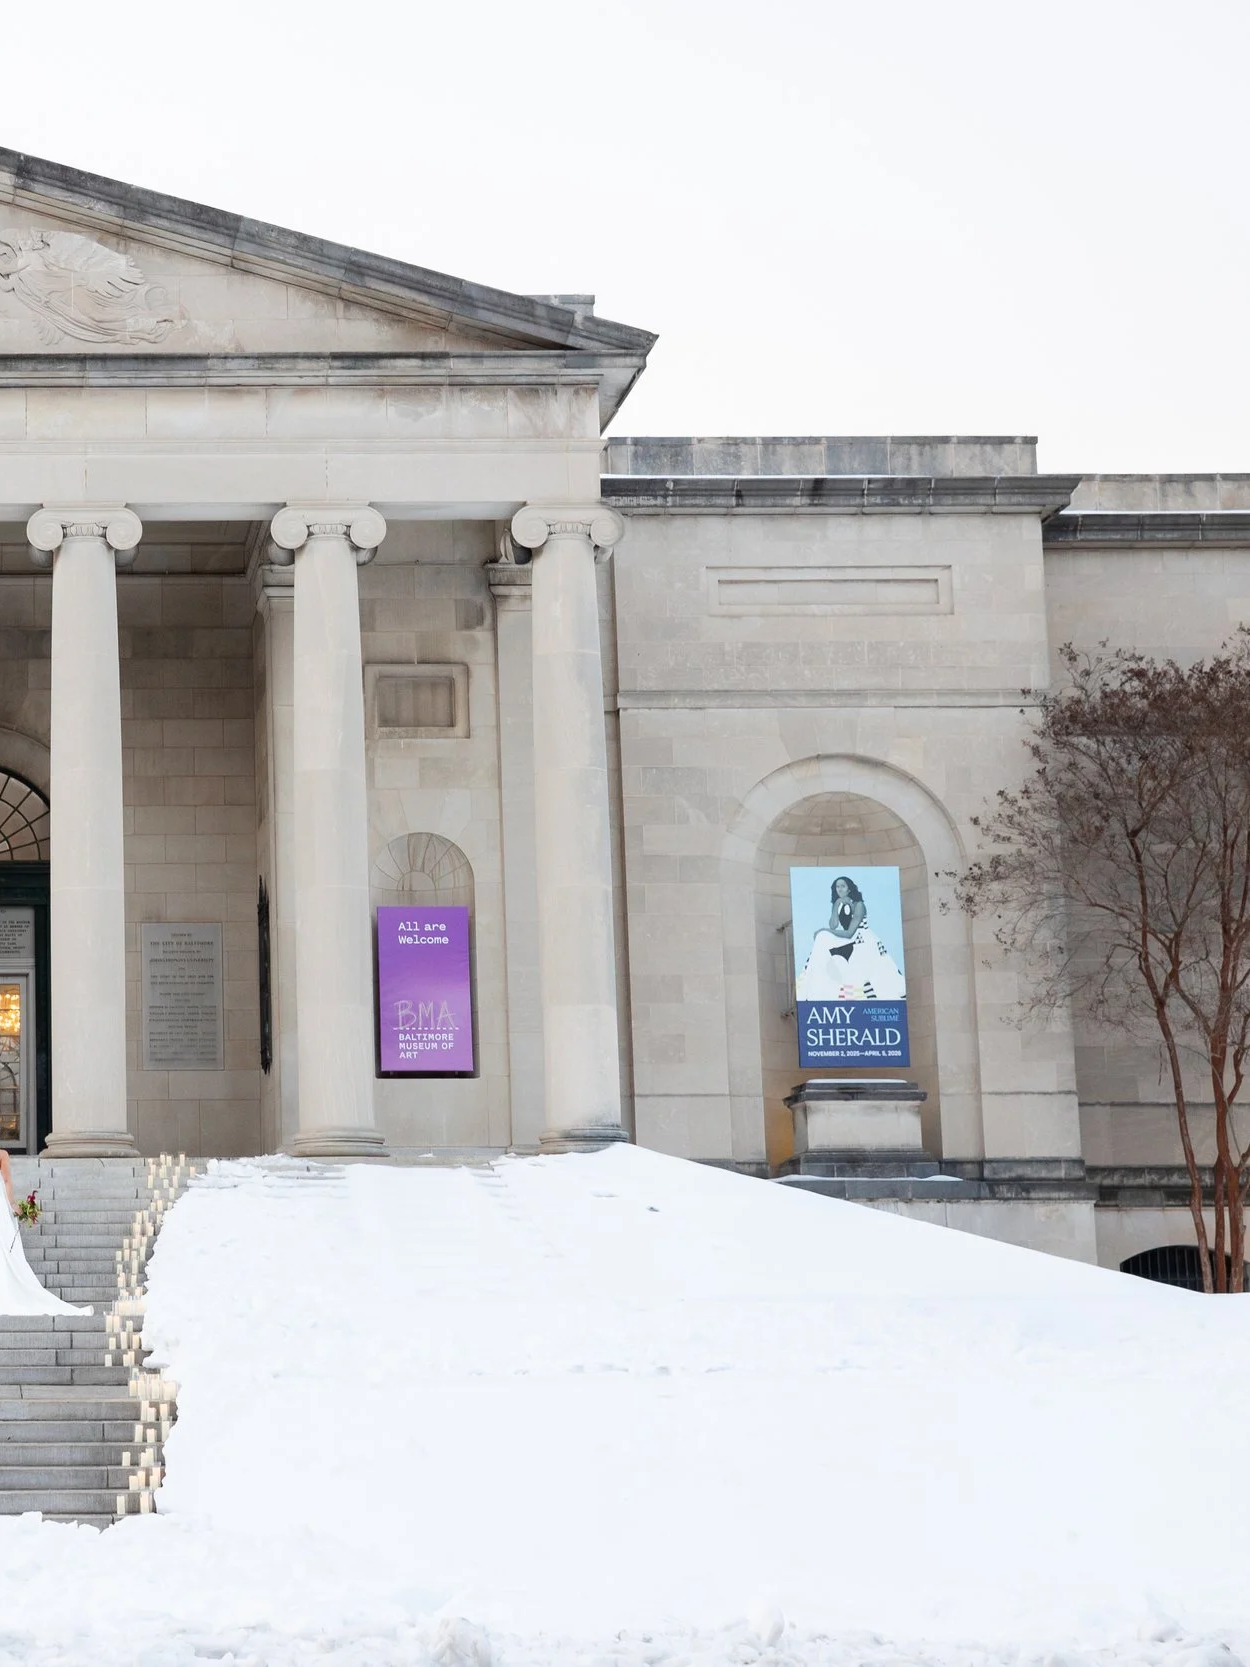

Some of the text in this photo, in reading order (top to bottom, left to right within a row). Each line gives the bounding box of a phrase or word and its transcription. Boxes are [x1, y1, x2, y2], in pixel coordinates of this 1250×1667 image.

[398, 921, 446, 931] All are
[398, 935, 449, 945] Welcome
[393, 999, 457, 1029] BMA
[806, 1007, 856, 1024] AMY
[871, 1014, 900, 1022] SUBLIME
[398, 1033, 454, 1041] BALTIMORE
[806, 1028, 901, 1047] SHERALD
[399, 1042, 454, 1050] MUSEUM OF
[399, 1051, 418, 1059] ART
